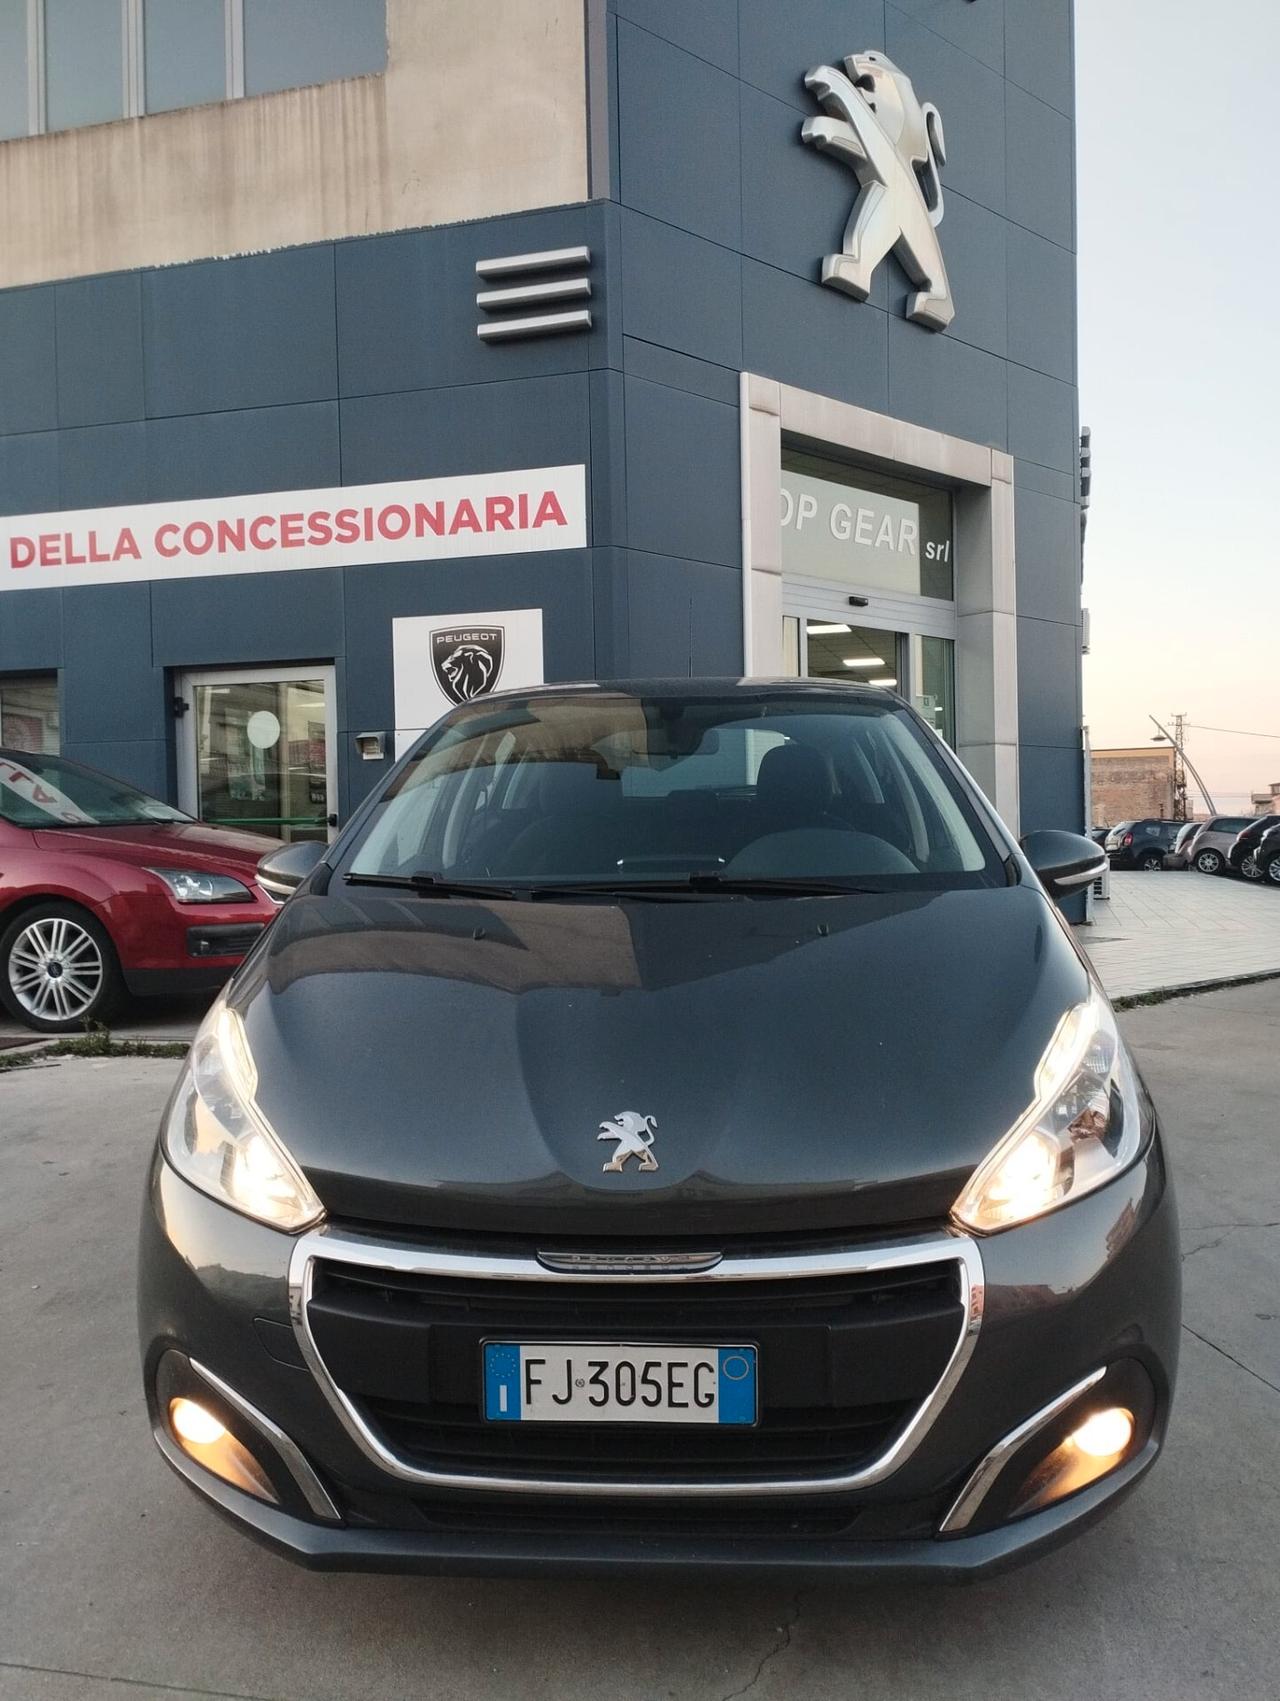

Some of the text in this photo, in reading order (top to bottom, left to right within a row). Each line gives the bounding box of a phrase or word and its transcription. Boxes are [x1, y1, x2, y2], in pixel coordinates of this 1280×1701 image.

[10, 490, 568, 569] DELLA CONCESSIONARIA
[830, 503, 918, 555] GEAR
[925, 540, 950, 562] srl
[436, 633, 497, 644] PEUGEOT
